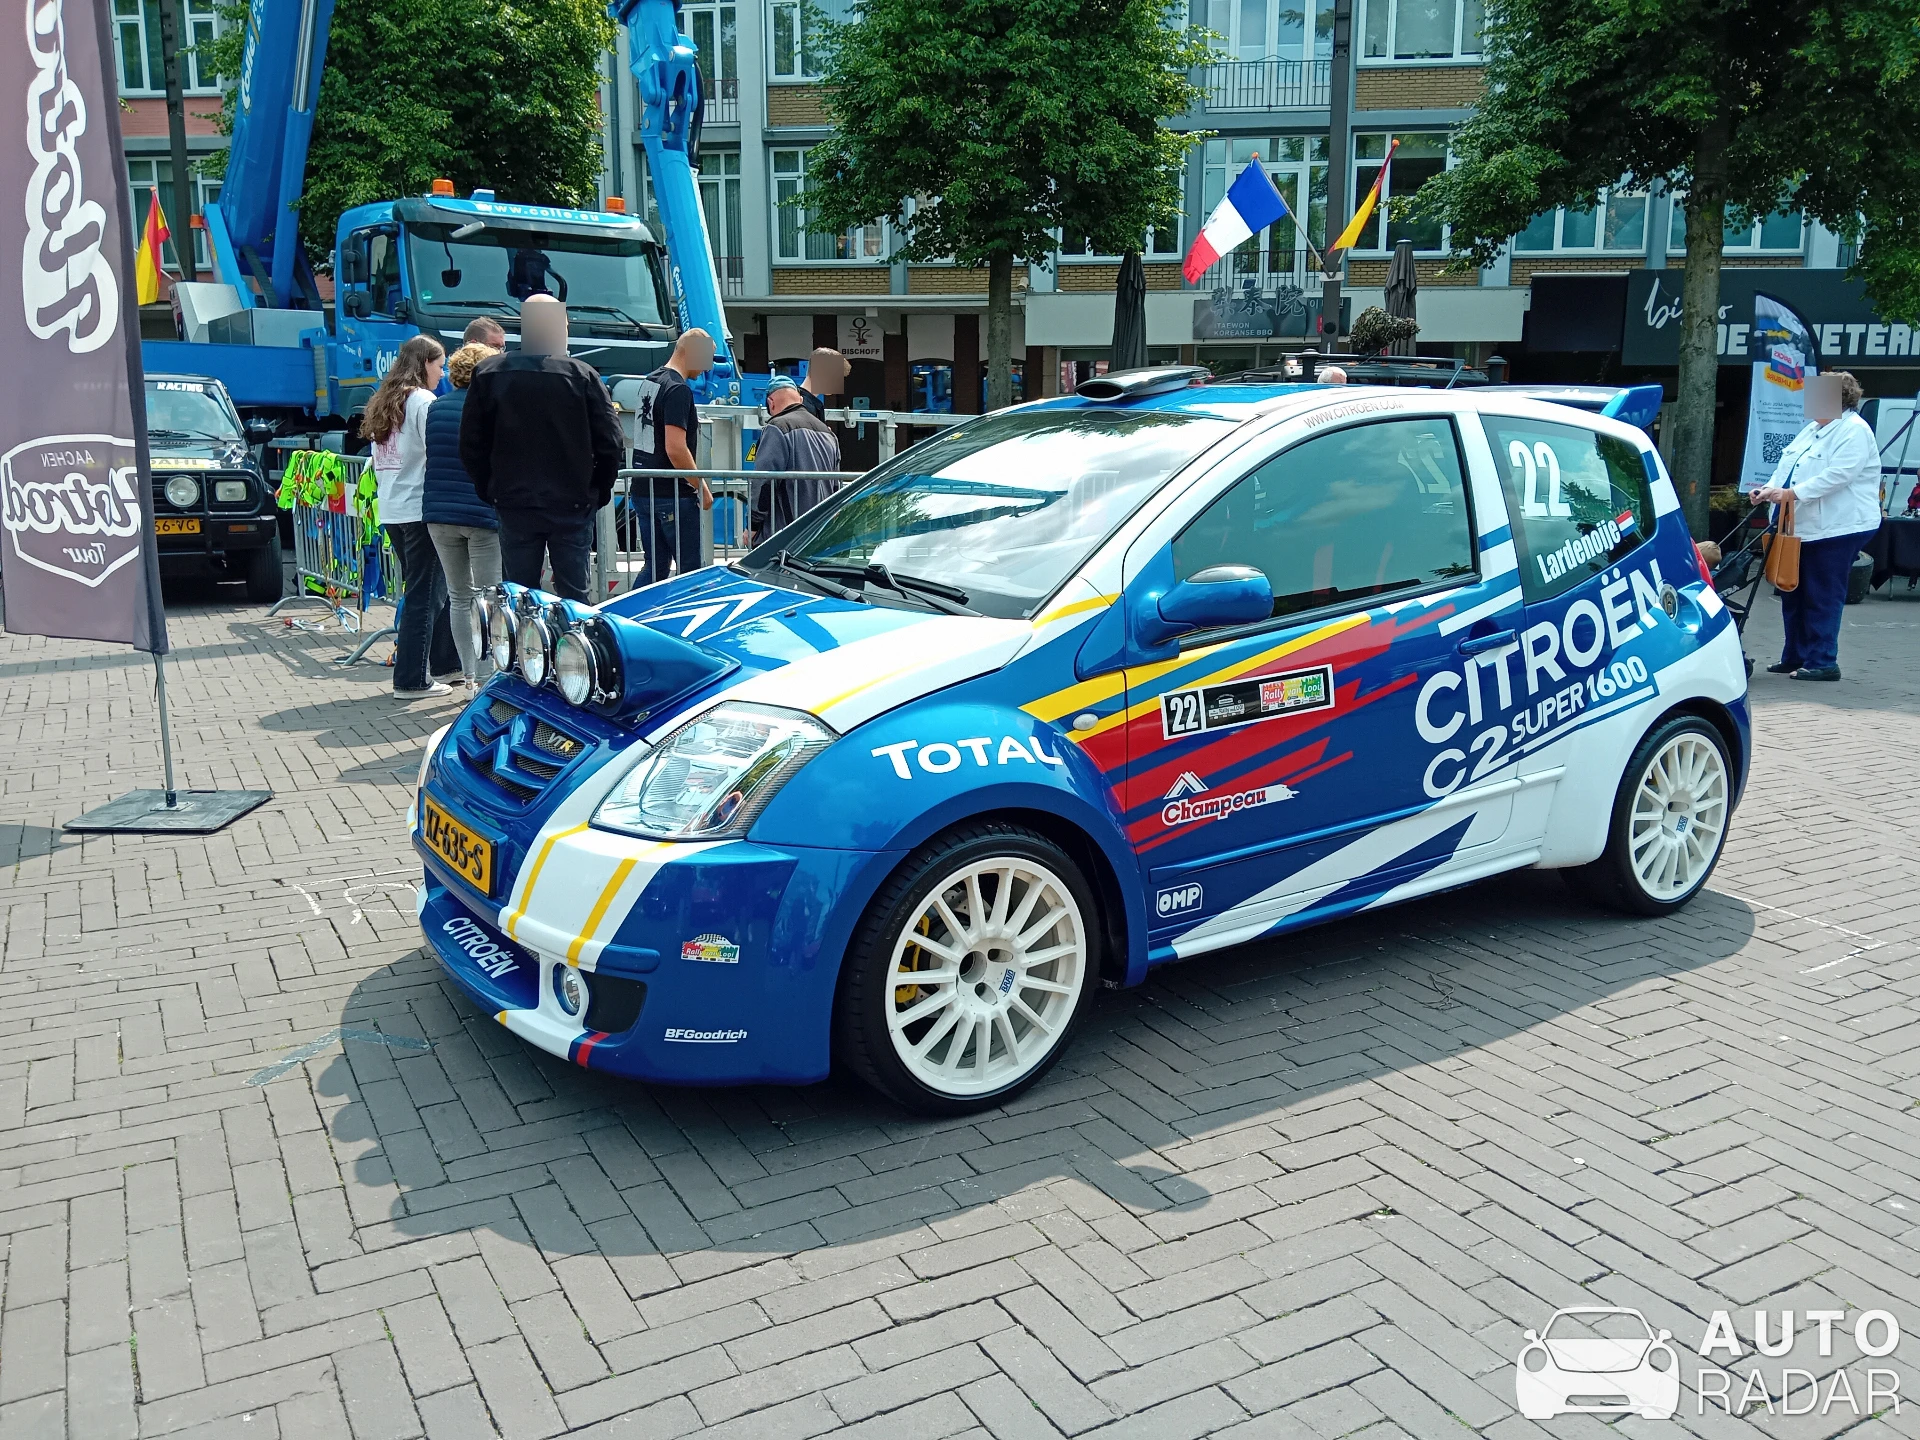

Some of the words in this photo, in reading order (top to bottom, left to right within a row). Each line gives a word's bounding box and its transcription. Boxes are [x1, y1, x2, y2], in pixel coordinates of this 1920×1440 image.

[156, 382, 204, 393] RACING
[1508, 440, 1572, 517] 22
[1536, 519, 1621, 584] Lardenoije
[1414, 558, 1666, 744] CITROËN
[1264, 688, 1285, 701] Rally
[1304, 681, 1321, 693] Looi
[1170, 694, 1199, 732] 22
[547, 732, 575, 752] VTR
[871, 736, 1063, 780] TOTAL
[1422, 726, 1508, 798] C2
[1163, 789, 1267, 824] Champeau
[425, 804, 484, 881] XZ-635-S
[1158, 886, 1201, 912] OMP
[442, 916, 520, 978] CITROËN
[686, 947, 703, 956] Rally
[664, 1028, 748, 1041] BFGoodrich
